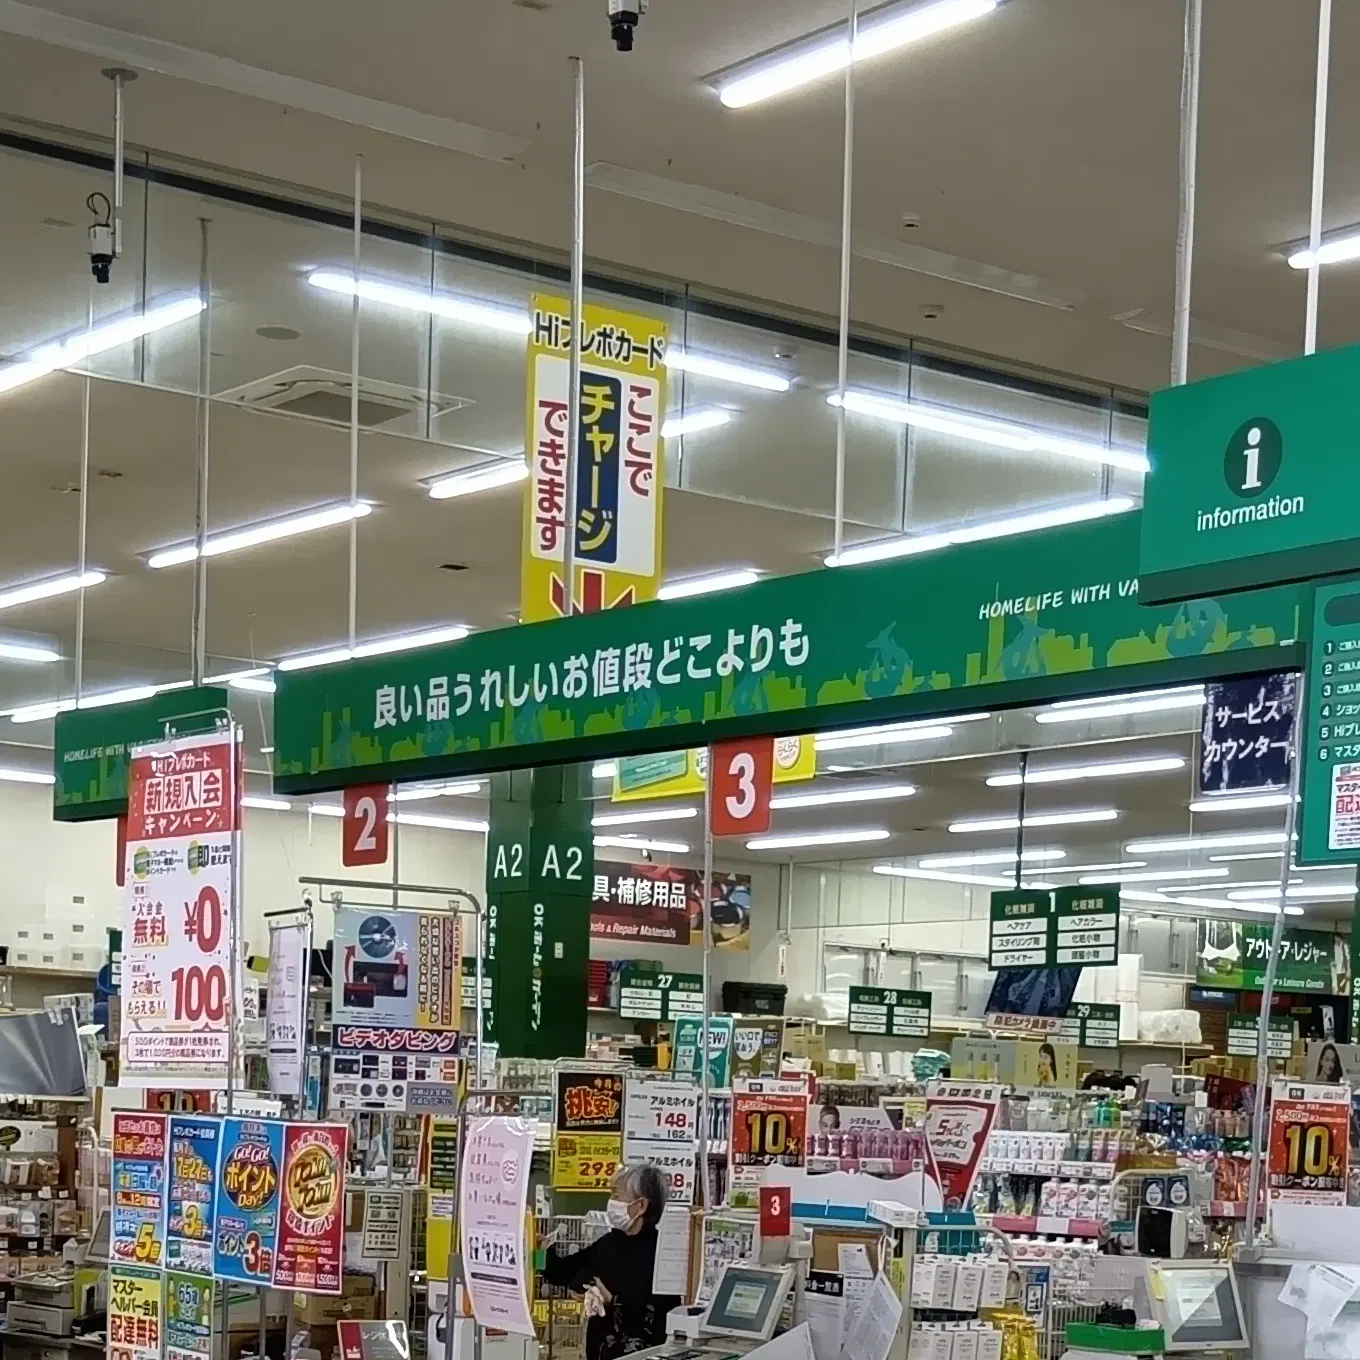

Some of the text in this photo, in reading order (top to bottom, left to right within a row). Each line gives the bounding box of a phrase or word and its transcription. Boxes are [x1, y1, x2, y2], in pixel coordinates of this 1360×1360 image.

[625, 384, 653, 498] ここで
[536, 399, 569, 551] できます
[577, 384, 616, 552] チャージ
[1196, 491, 1305, 533] information
[978, 583, 1111, 621] HOMELIFE WITH
[373, 617, 810, 731] 良い品うれしいお値段どこよりも
[1215, 700, 1282, 727] サービス
[1203, 738, 1291, 764] カウンター
[145, 771, 220, 813] 新規入会
[725, 752, 757, 820] 3
[353, 796, 378, 853] 2
[494, 843, 523, 880] A2
[541, 846, 583, 881] A2
[133, 916, 167, 944] 無料
[657, 975, 673, 989] 27
[883, 990, 898, 1005] 28
[1077, 1005, 1090, 1018] 29
[337, 1027, 457, 1053] ビデオダビング
[650, 1094, 696, 1108] アルミホイル
[666, 1130, 686, 1139] 162
[225, 1161, 276, 1195] ポイント
[648, 1157, 694, 1168] アルミホイル
[770, 1195, 780, 1217] 3
